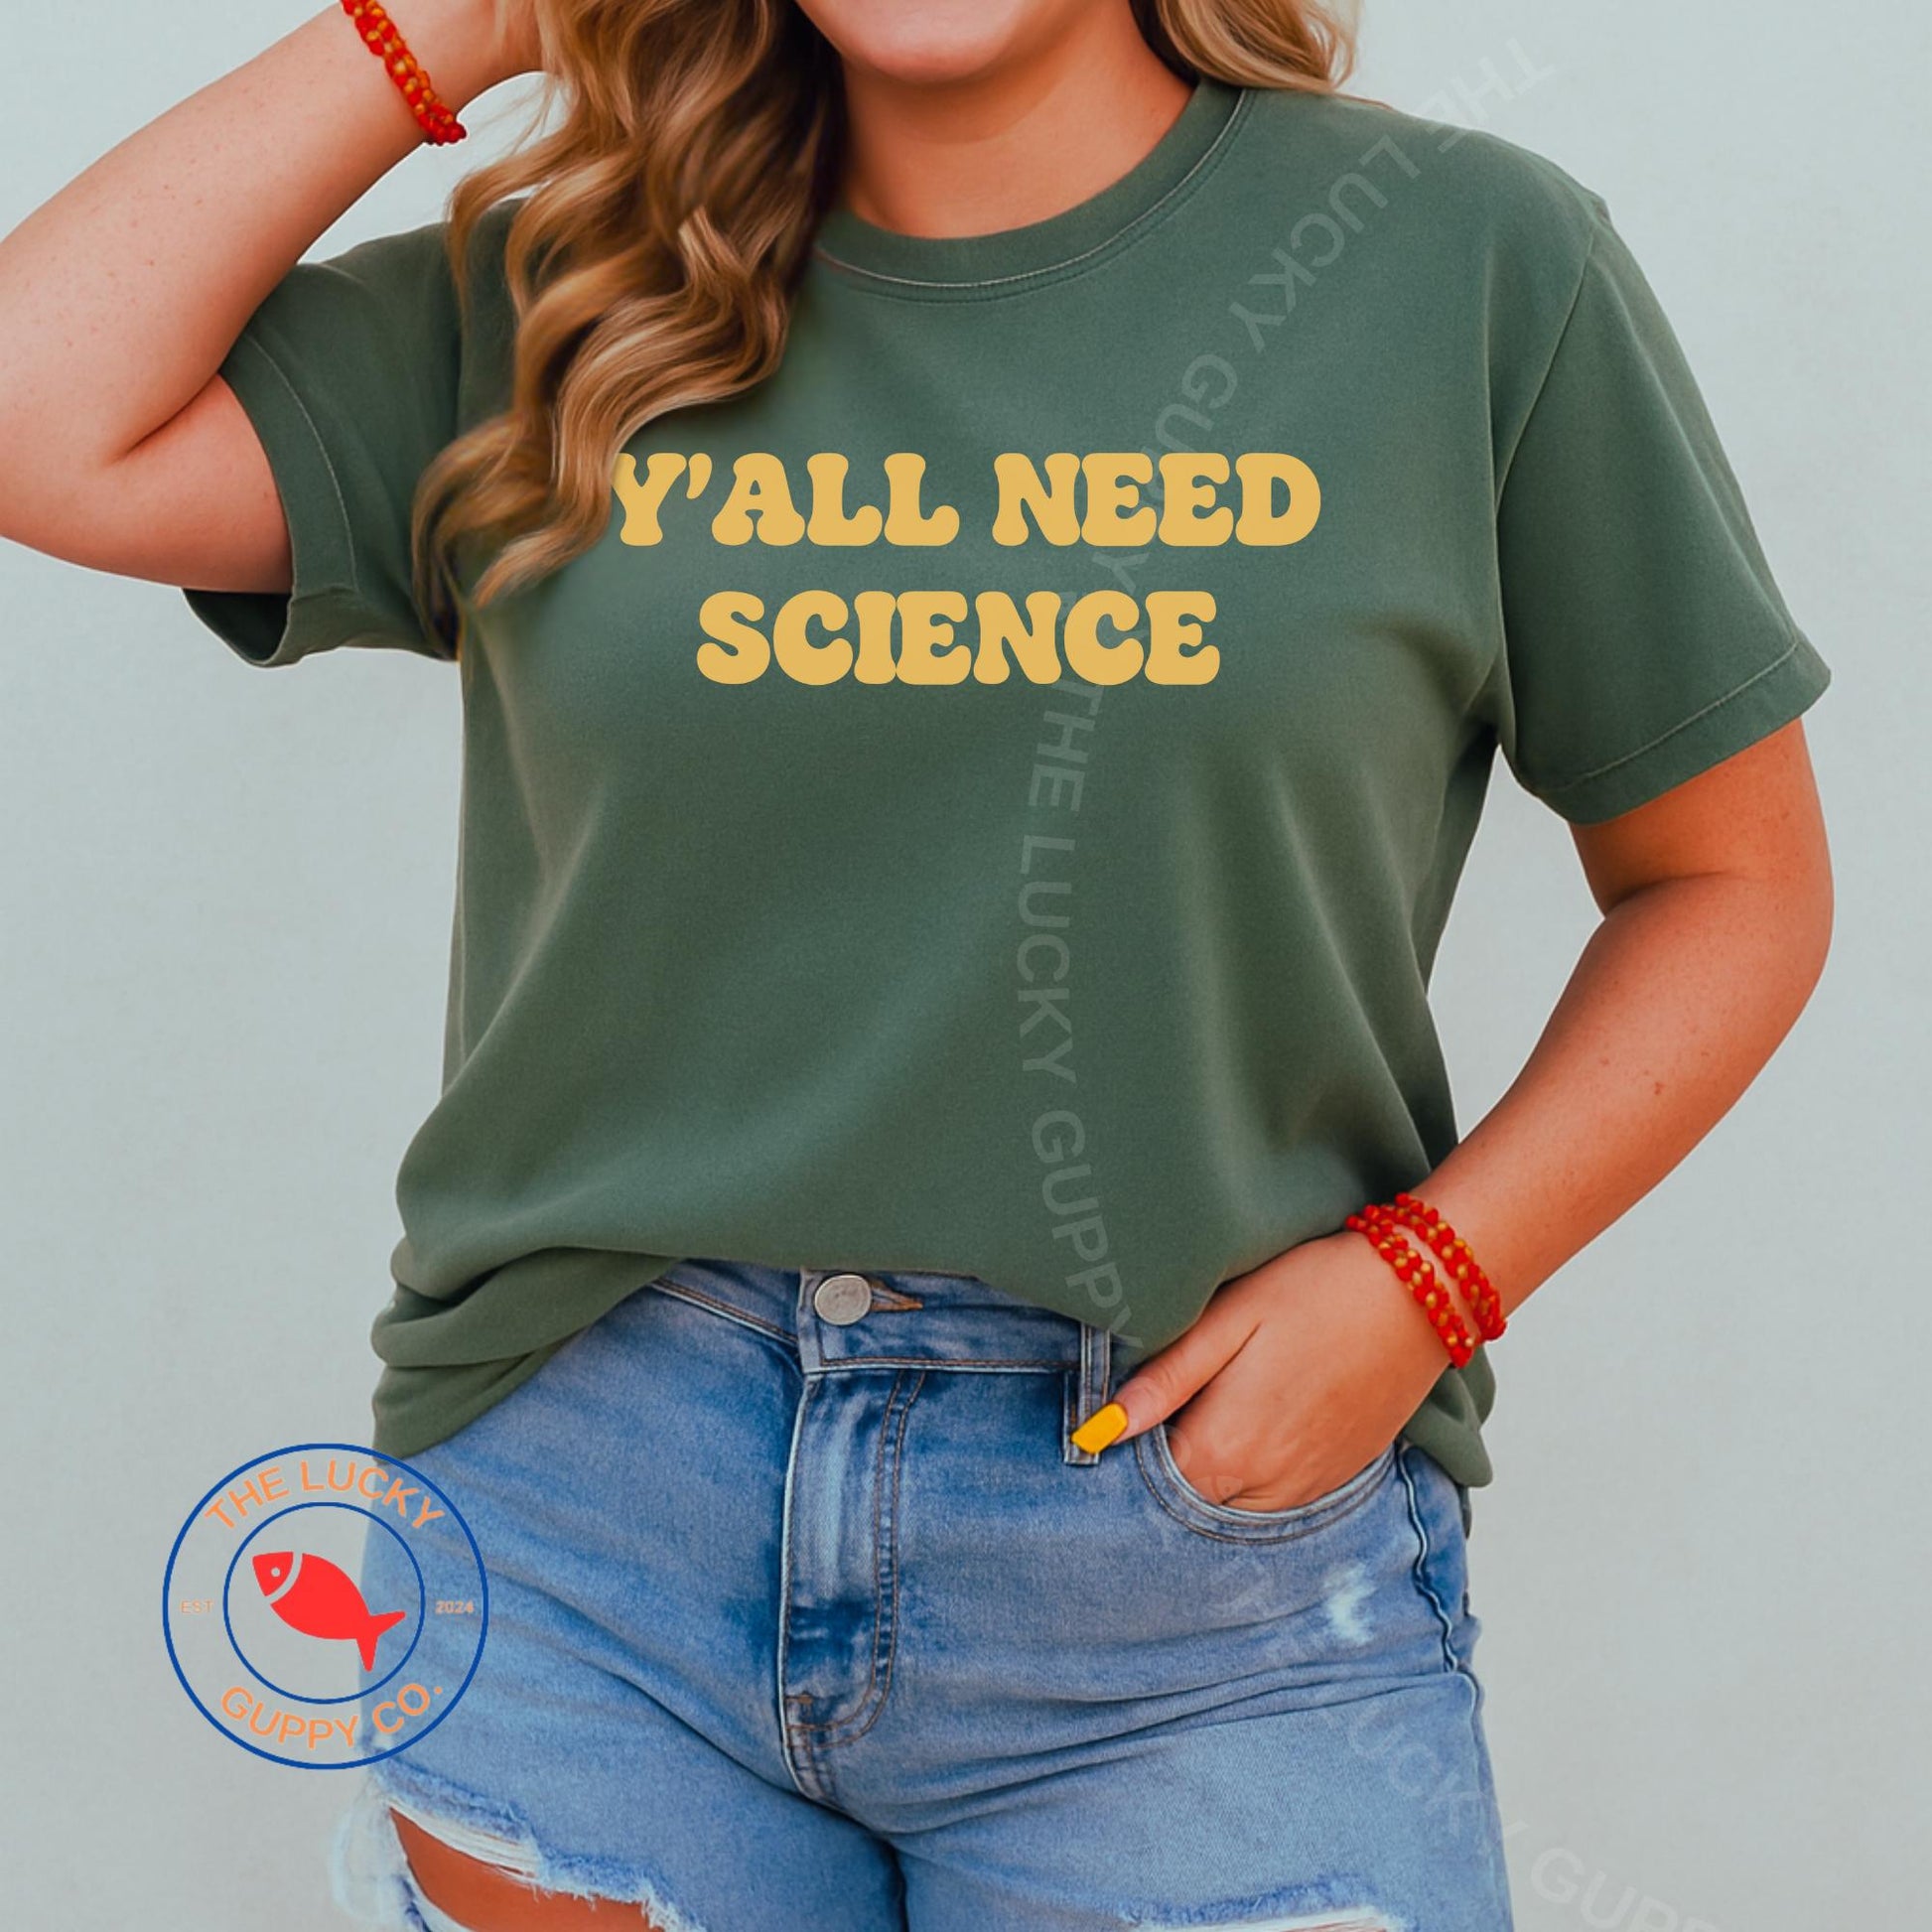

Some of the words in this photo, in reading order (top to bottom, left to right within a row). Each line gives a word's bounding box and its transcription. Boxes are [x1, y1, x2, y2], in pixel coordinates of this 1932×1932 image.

[611, 453, 960, 547] Y'ALL
[992, 453, 1321, 547] NEED
[696, 590, 1221, 686] SCIENCE
